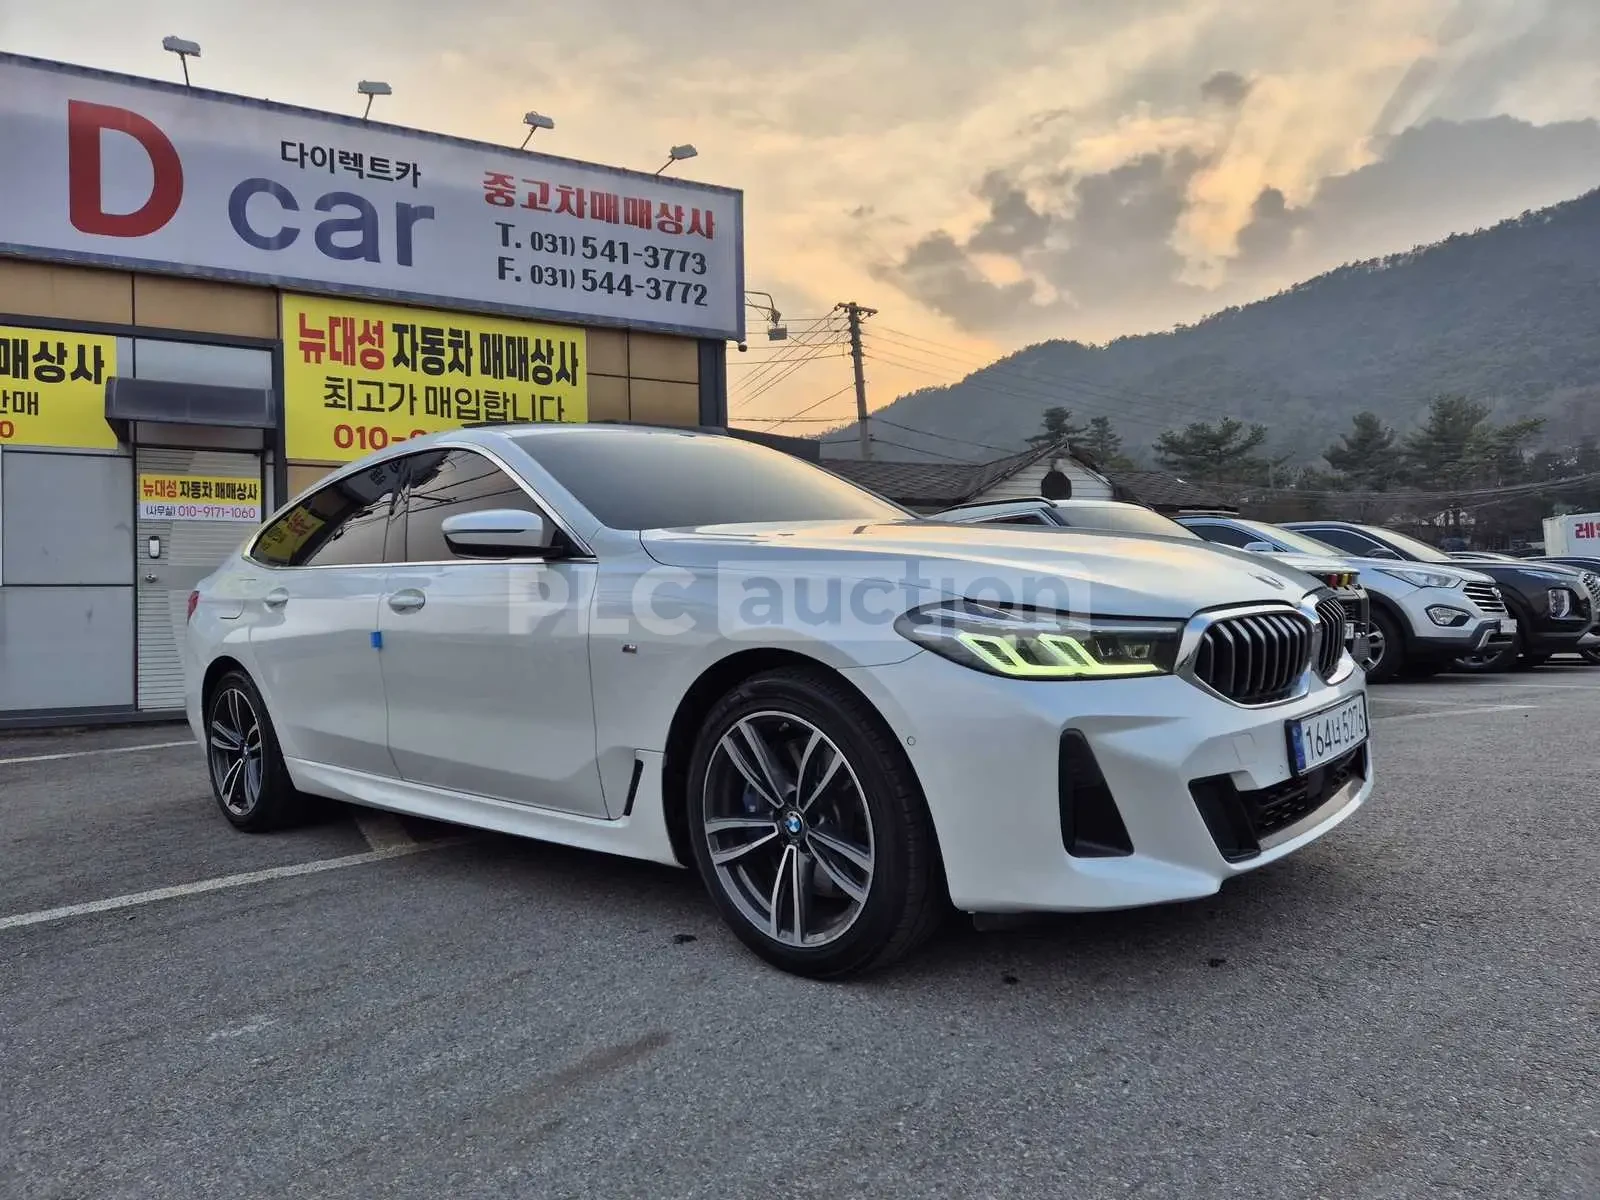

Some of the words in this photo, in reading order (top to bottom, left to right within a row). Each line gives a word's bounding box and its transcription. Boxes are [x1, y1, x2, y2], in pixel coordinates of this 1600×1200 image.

[67, 99, 184, 237] D
[228, 178, 435, 266] car
[280, 140, 421, 188] 다이렉트카
[483, 171, 716, 240] 중고차매매상사
[495, 222, 522, 249] T.
[581, 236, 708, 275] 541-3773
[497, 256, 522, 282] F.
[581, 269, 709, 307] 544-3772
[298, 312, 386, 371] 뉴대성
[392, 322, 473, 377] 자동차
[479, 332, 579, 387] 매매상사
[323, 375, 417, 416] 최고가
[424, 386, 566, 422] 매입합니다
[143, 479, 177, 498] 뉴대성
[179, 480, 213, 499] 자동차
[215, 482, 258, 501] 매매상사
[178, 505, 256, 519] 010-9171-1060
